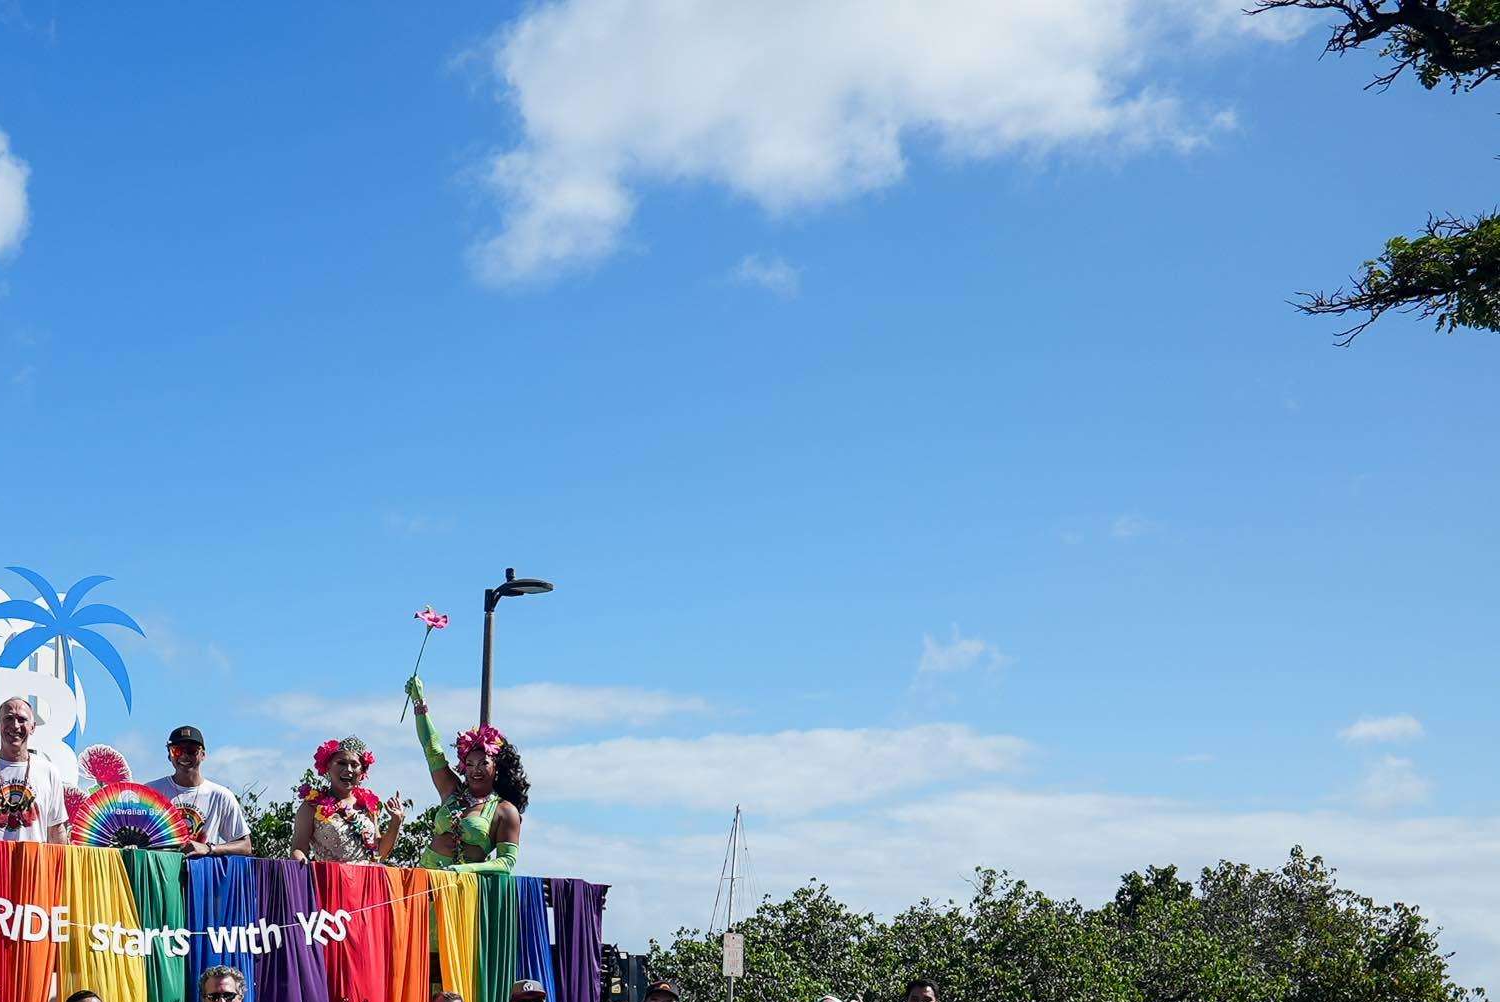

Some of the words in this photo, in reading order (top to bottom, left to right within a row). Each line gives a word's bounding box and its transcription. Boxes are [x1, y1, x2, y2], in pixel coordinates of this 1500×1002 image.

[91, 921, 190, 957] starts
[207, 917, 281, 955] with
[296, 908, 352, 947] YES
